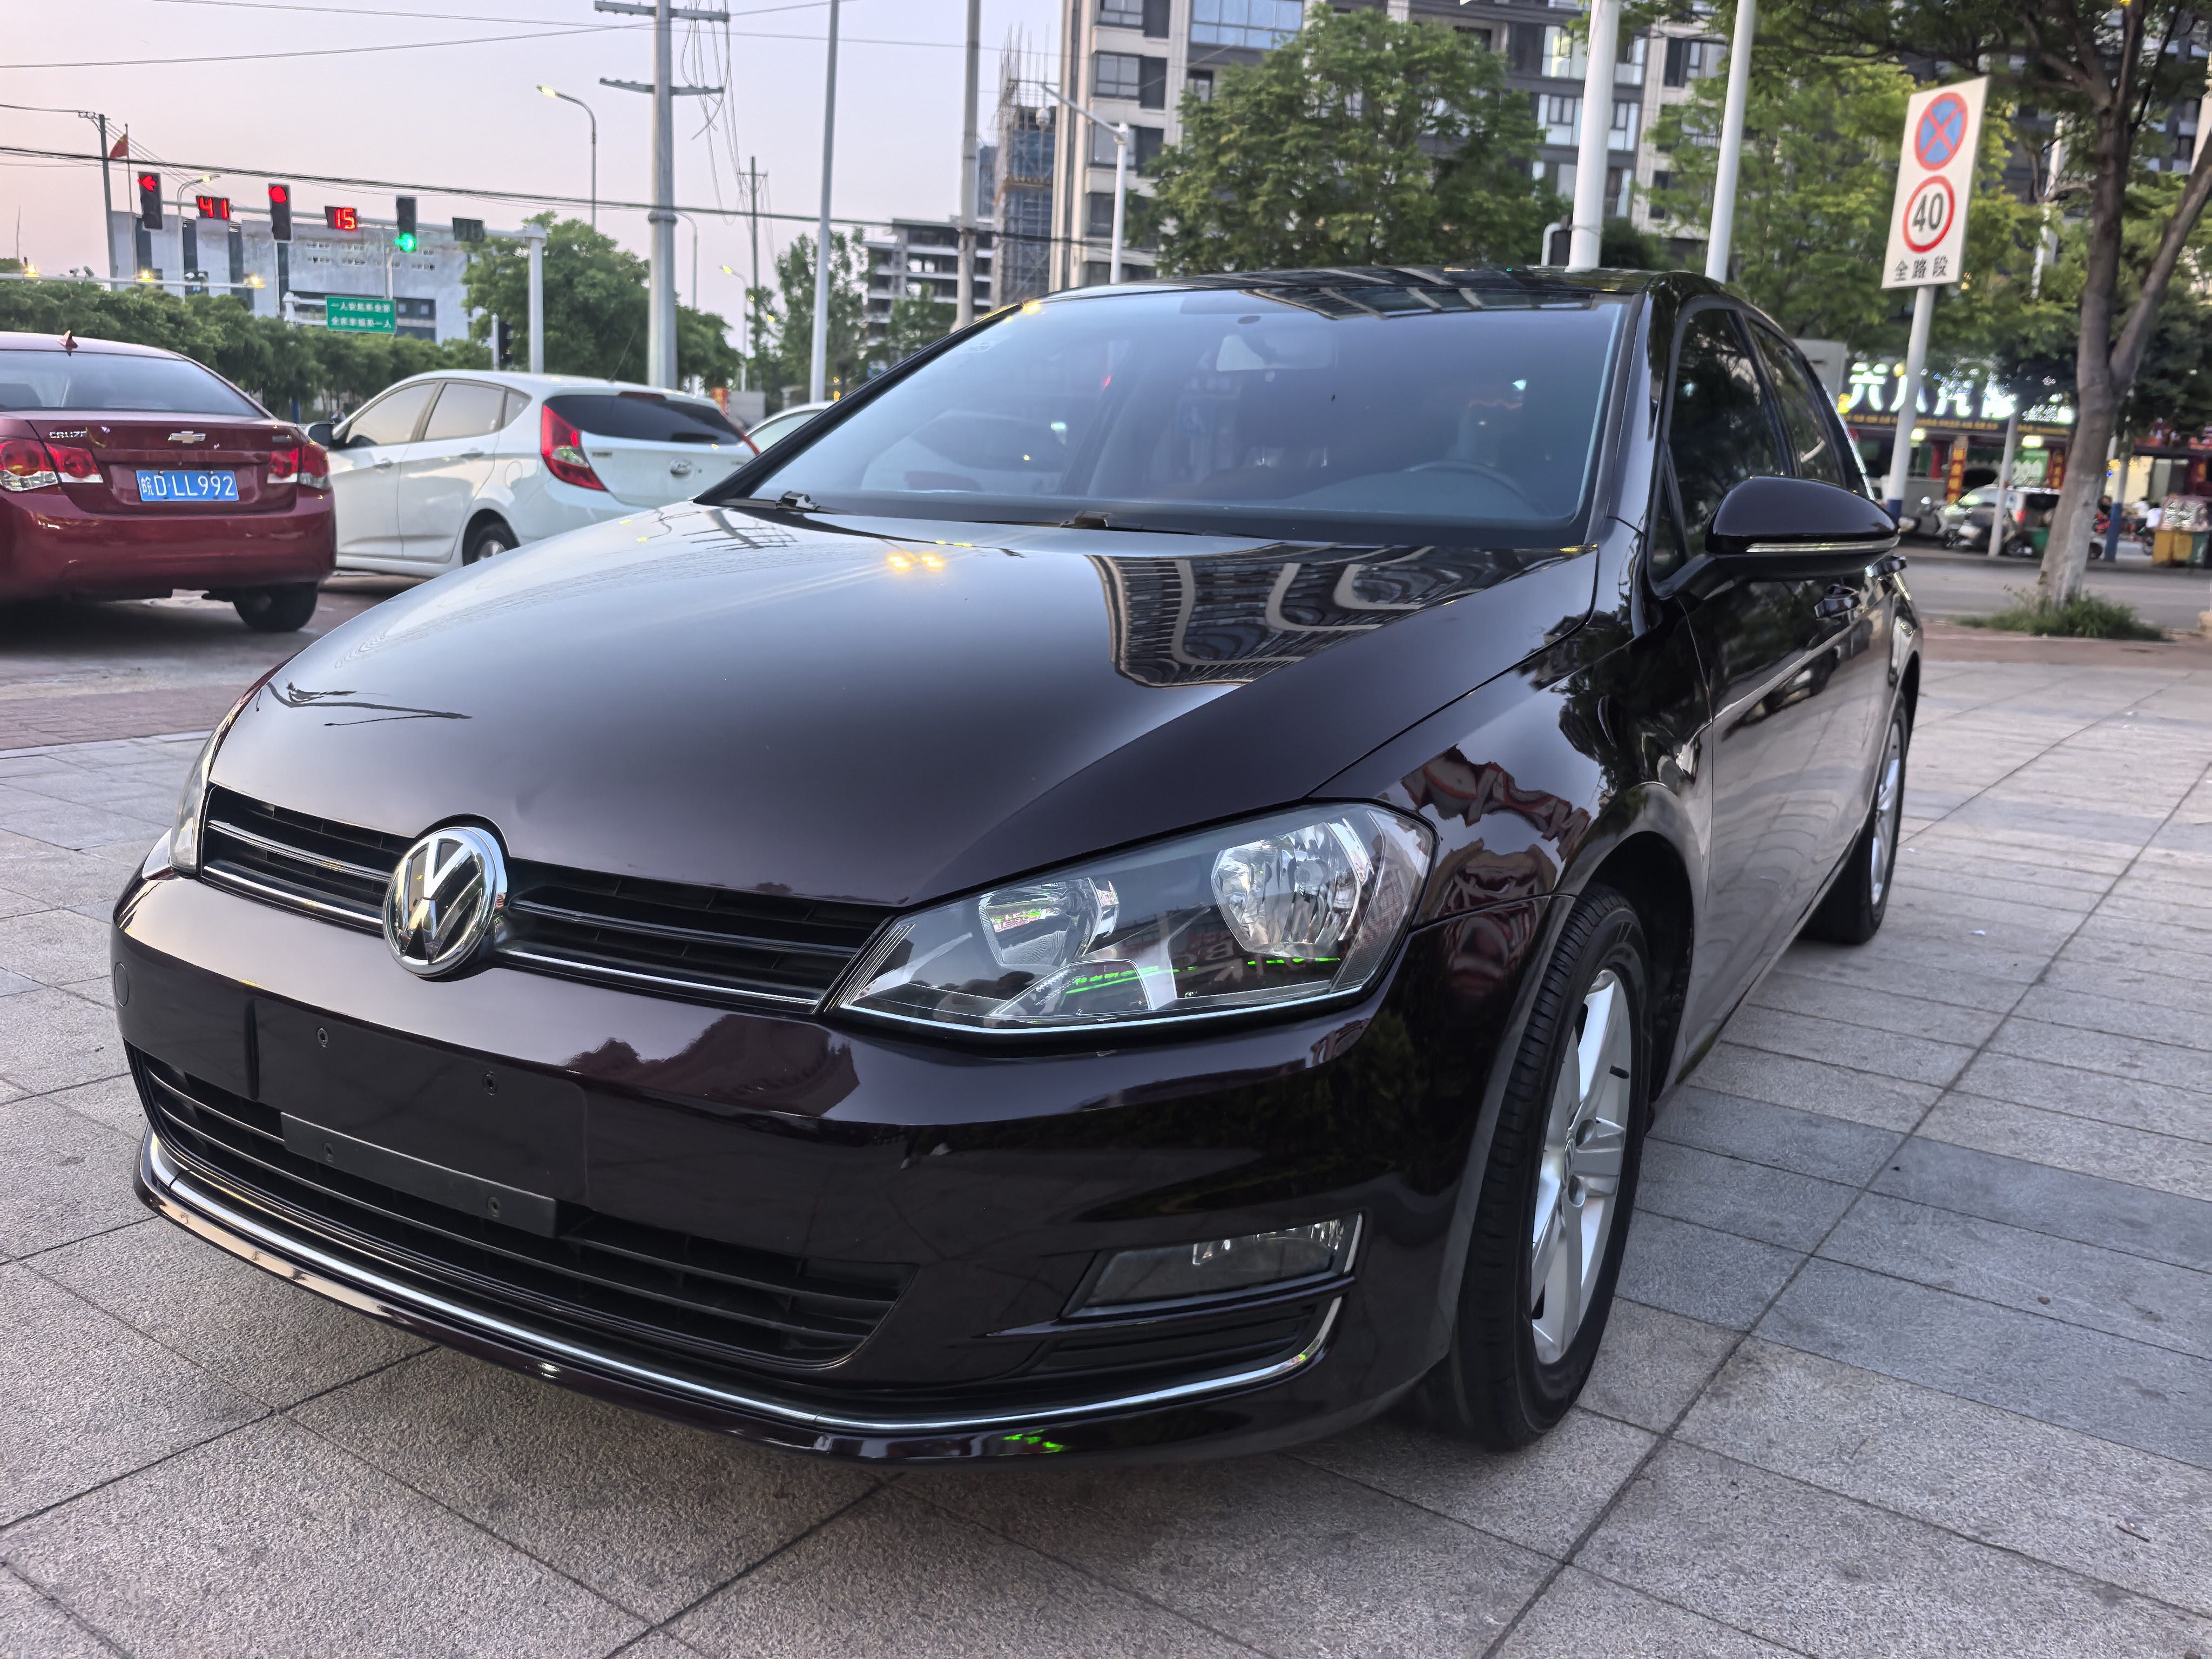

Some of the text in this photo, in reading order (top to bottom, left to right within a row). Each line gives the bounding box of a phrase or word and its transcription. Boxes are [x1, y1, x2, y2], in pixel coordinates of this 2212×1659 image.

[198, 195, 230, 220] 41
[334, 206, 357, 231] 15
[1911, 192, 1944, 233] 40
[1893, 254, 1948, 282] 全路段
